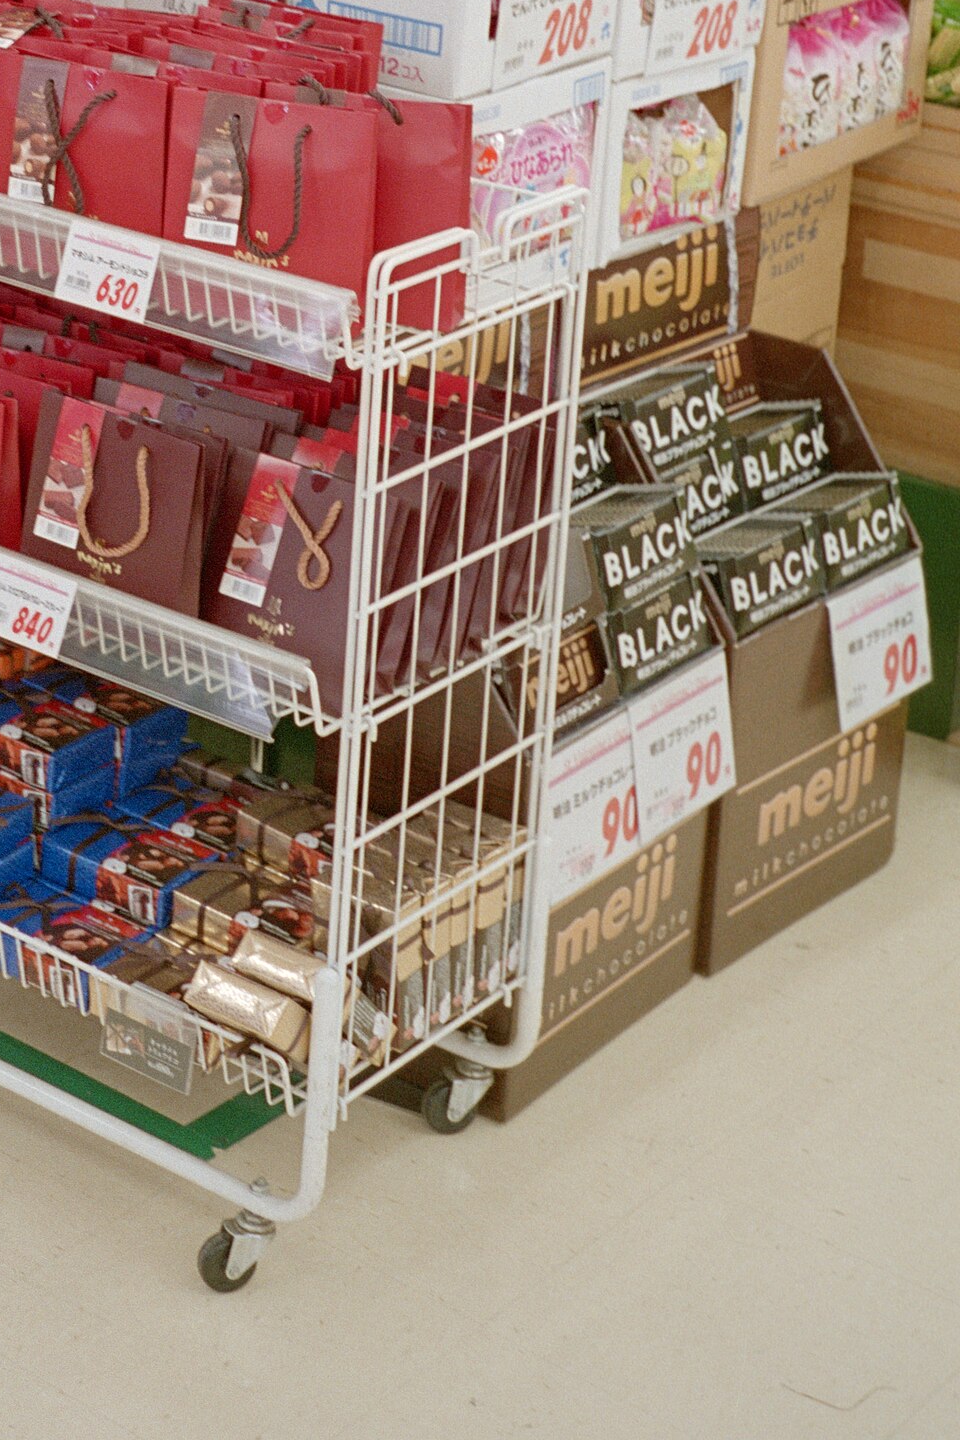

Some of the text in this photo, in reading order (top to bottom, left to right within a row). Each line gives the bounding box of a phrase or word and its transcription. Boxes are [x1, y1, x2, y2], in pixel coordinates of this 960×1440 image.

[686, 0, 739, 59] 208
[96, 274, 139, 311] 630
[595, 223, 720, 325] meiji
[579, 301, 731, 372] ilkchocolate
[631, 384, 726, 453] BLACK
[742, 422, 830, 488] BLACK
[687, 460, 740, 521] ACK
[603, 510, 693, 588] BLACK
[823, 496, 906, 566] BLACK
[730, 538, 820, 612] BLACK
[11, 606, 54, 644] 840
[616, 589, 707, 669] BLACK
[884, 633, 917, 695] 90
[686, 730, 722, 800] 90
[757, 721, 879, 847] meiji
[602, 784, 638, 858] 90
[553, 833, 678, 978] meiji
[547, 908, 689, 1022] ilkchocolate
